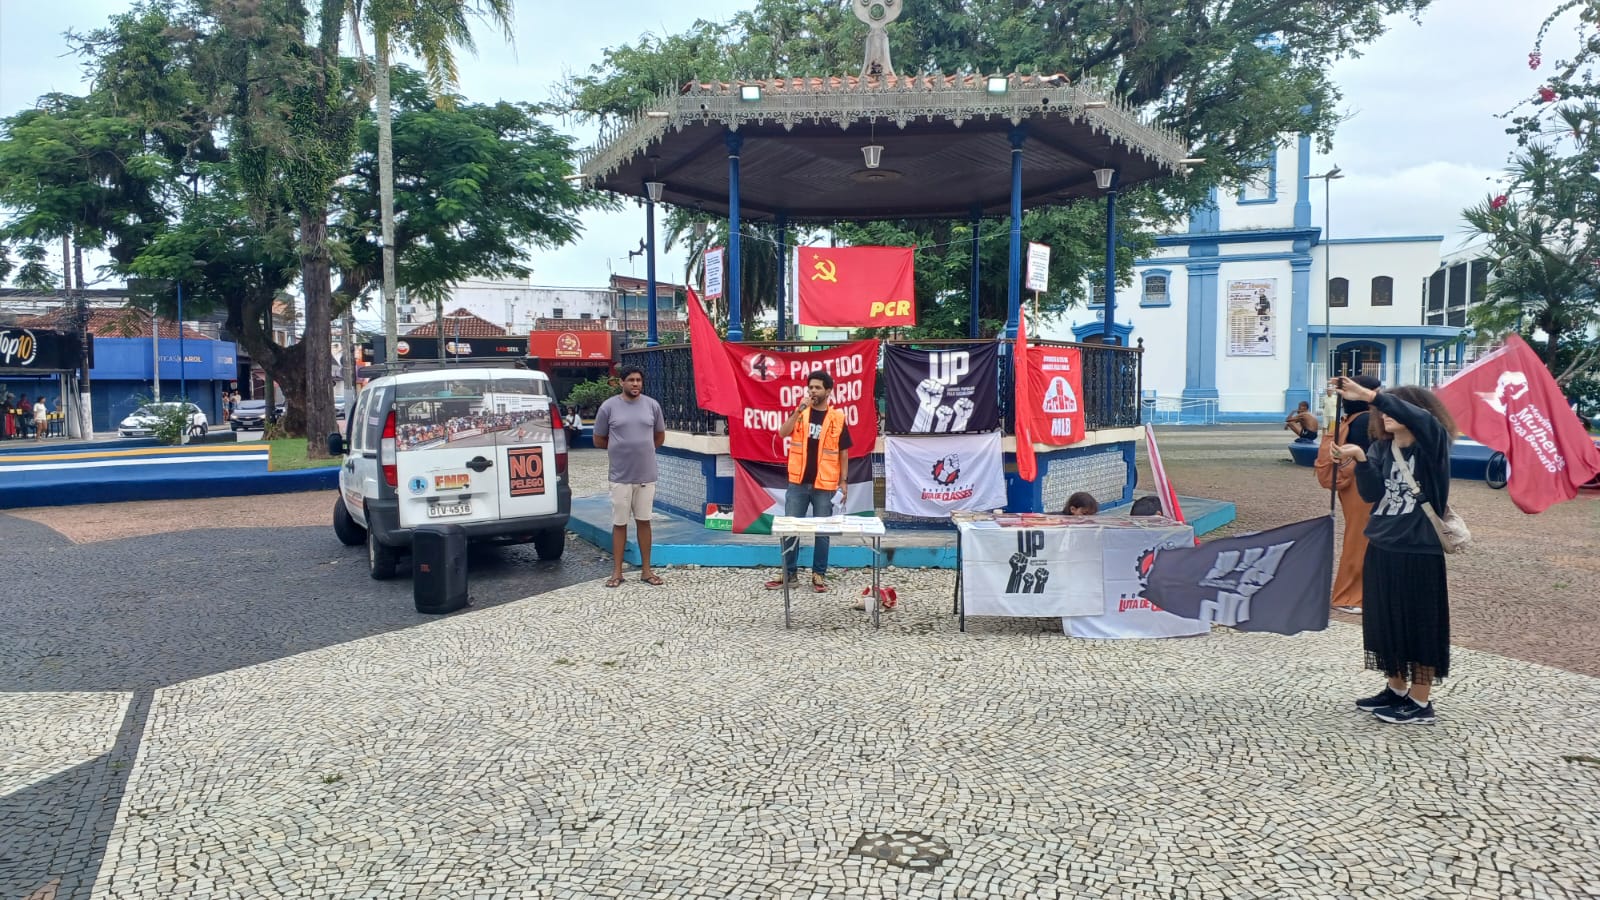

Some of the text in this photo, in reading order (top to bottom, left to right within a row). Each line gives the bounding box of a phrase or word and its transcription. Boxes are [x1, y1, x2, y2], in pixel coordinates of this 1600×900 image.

[869, 301, 911, 318] PCR
[183, 355, 203, 363] AROL
[790, 353, 863, 380] PARTIDO
[929, 351, 970, 386] UP
[510, 453, 543, 478] NO
[1524, 434, 1557, 473] Benario
[511, 478, 543, 488] PELEGO
[1017, 529, 1045, 558] UP
[1119, 599, 1139, 612] LUTA
[1139, 599, 1151, 609] DE
